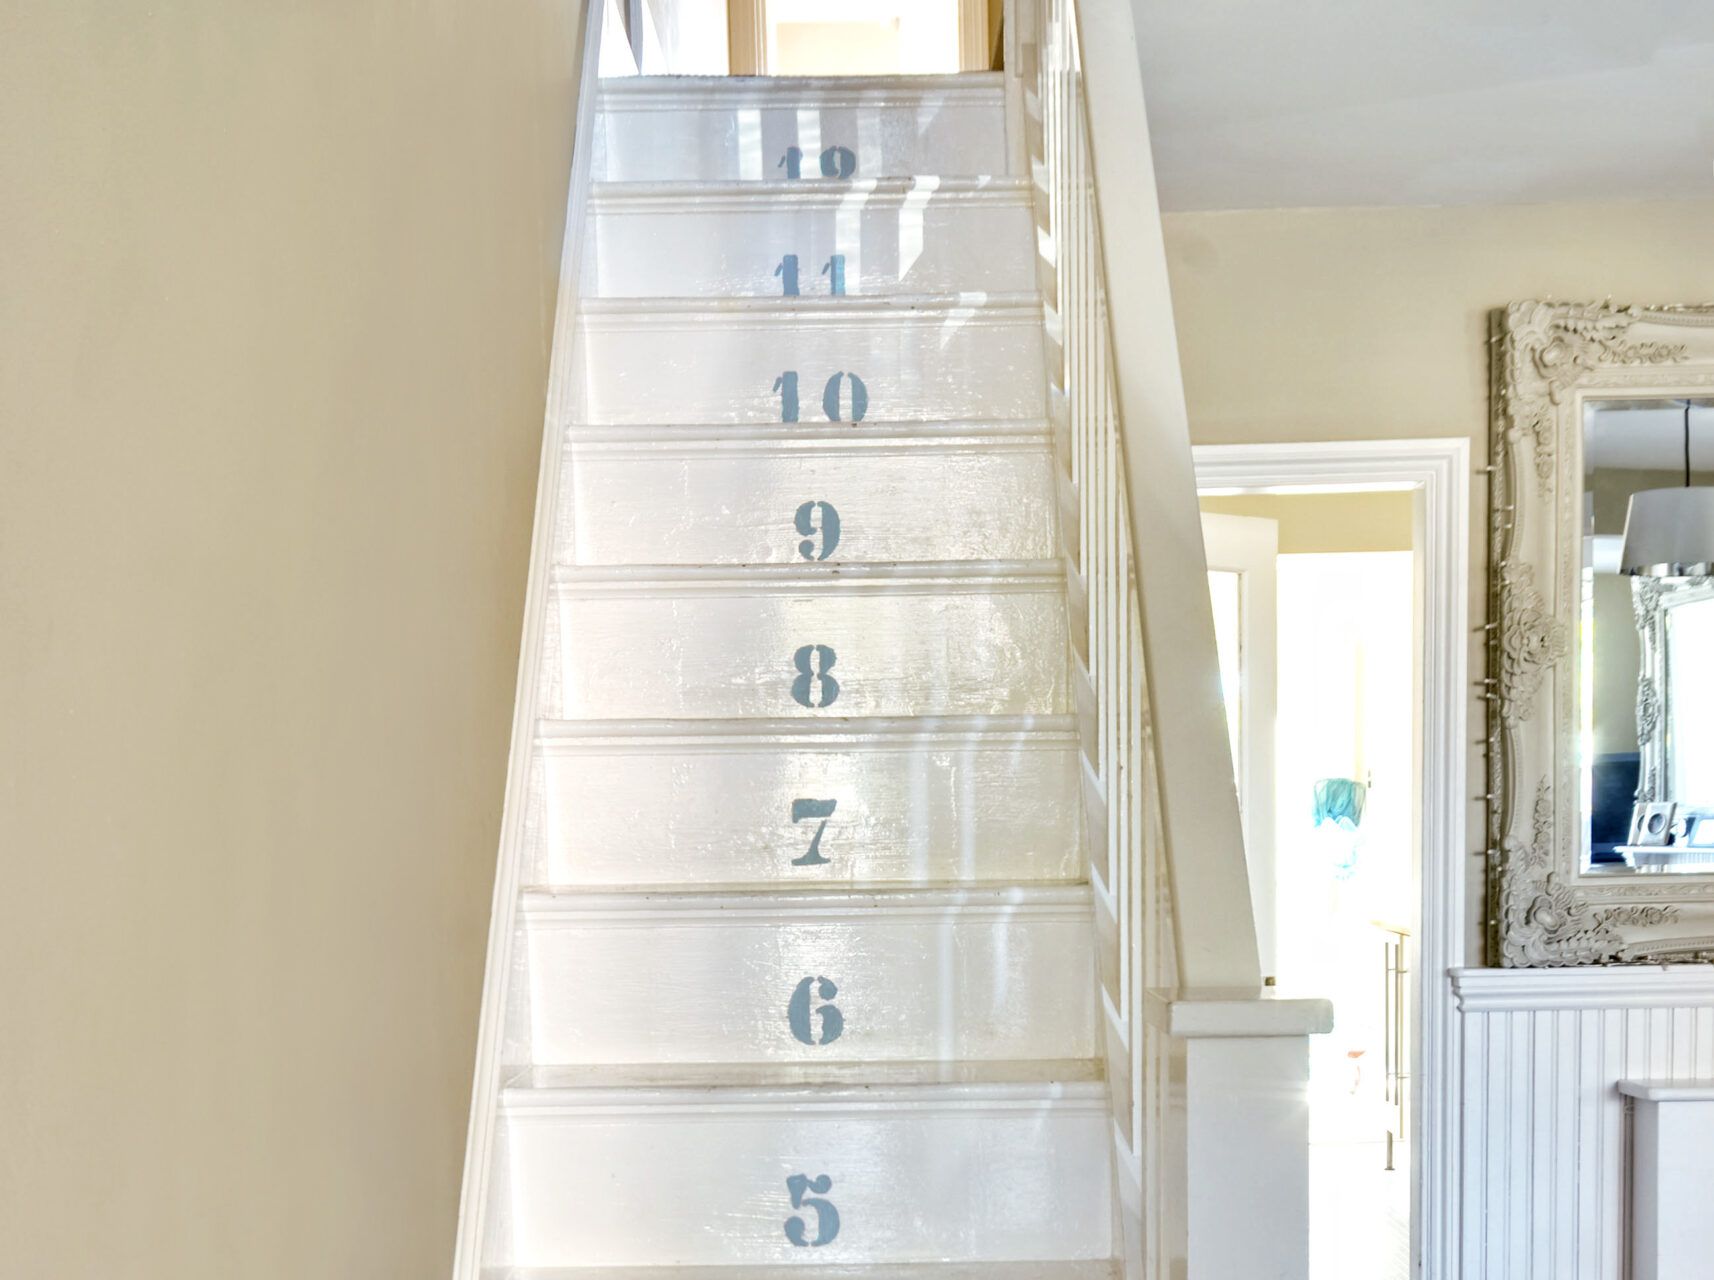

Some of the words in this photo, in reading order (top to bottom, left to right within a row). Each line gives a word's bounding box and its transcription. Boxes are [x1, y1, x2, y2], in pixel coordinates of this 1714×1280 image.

[773, 253, 847, 297] 11
[772, 370, 869, 423] 10
[793, 499, 842, 561] 9
[790, 644, 840, 708] 8
[790, 798, 837, 866] 7
[786, 975, 844, 1046] 6
[783, 1173, 842, 1248] 5
